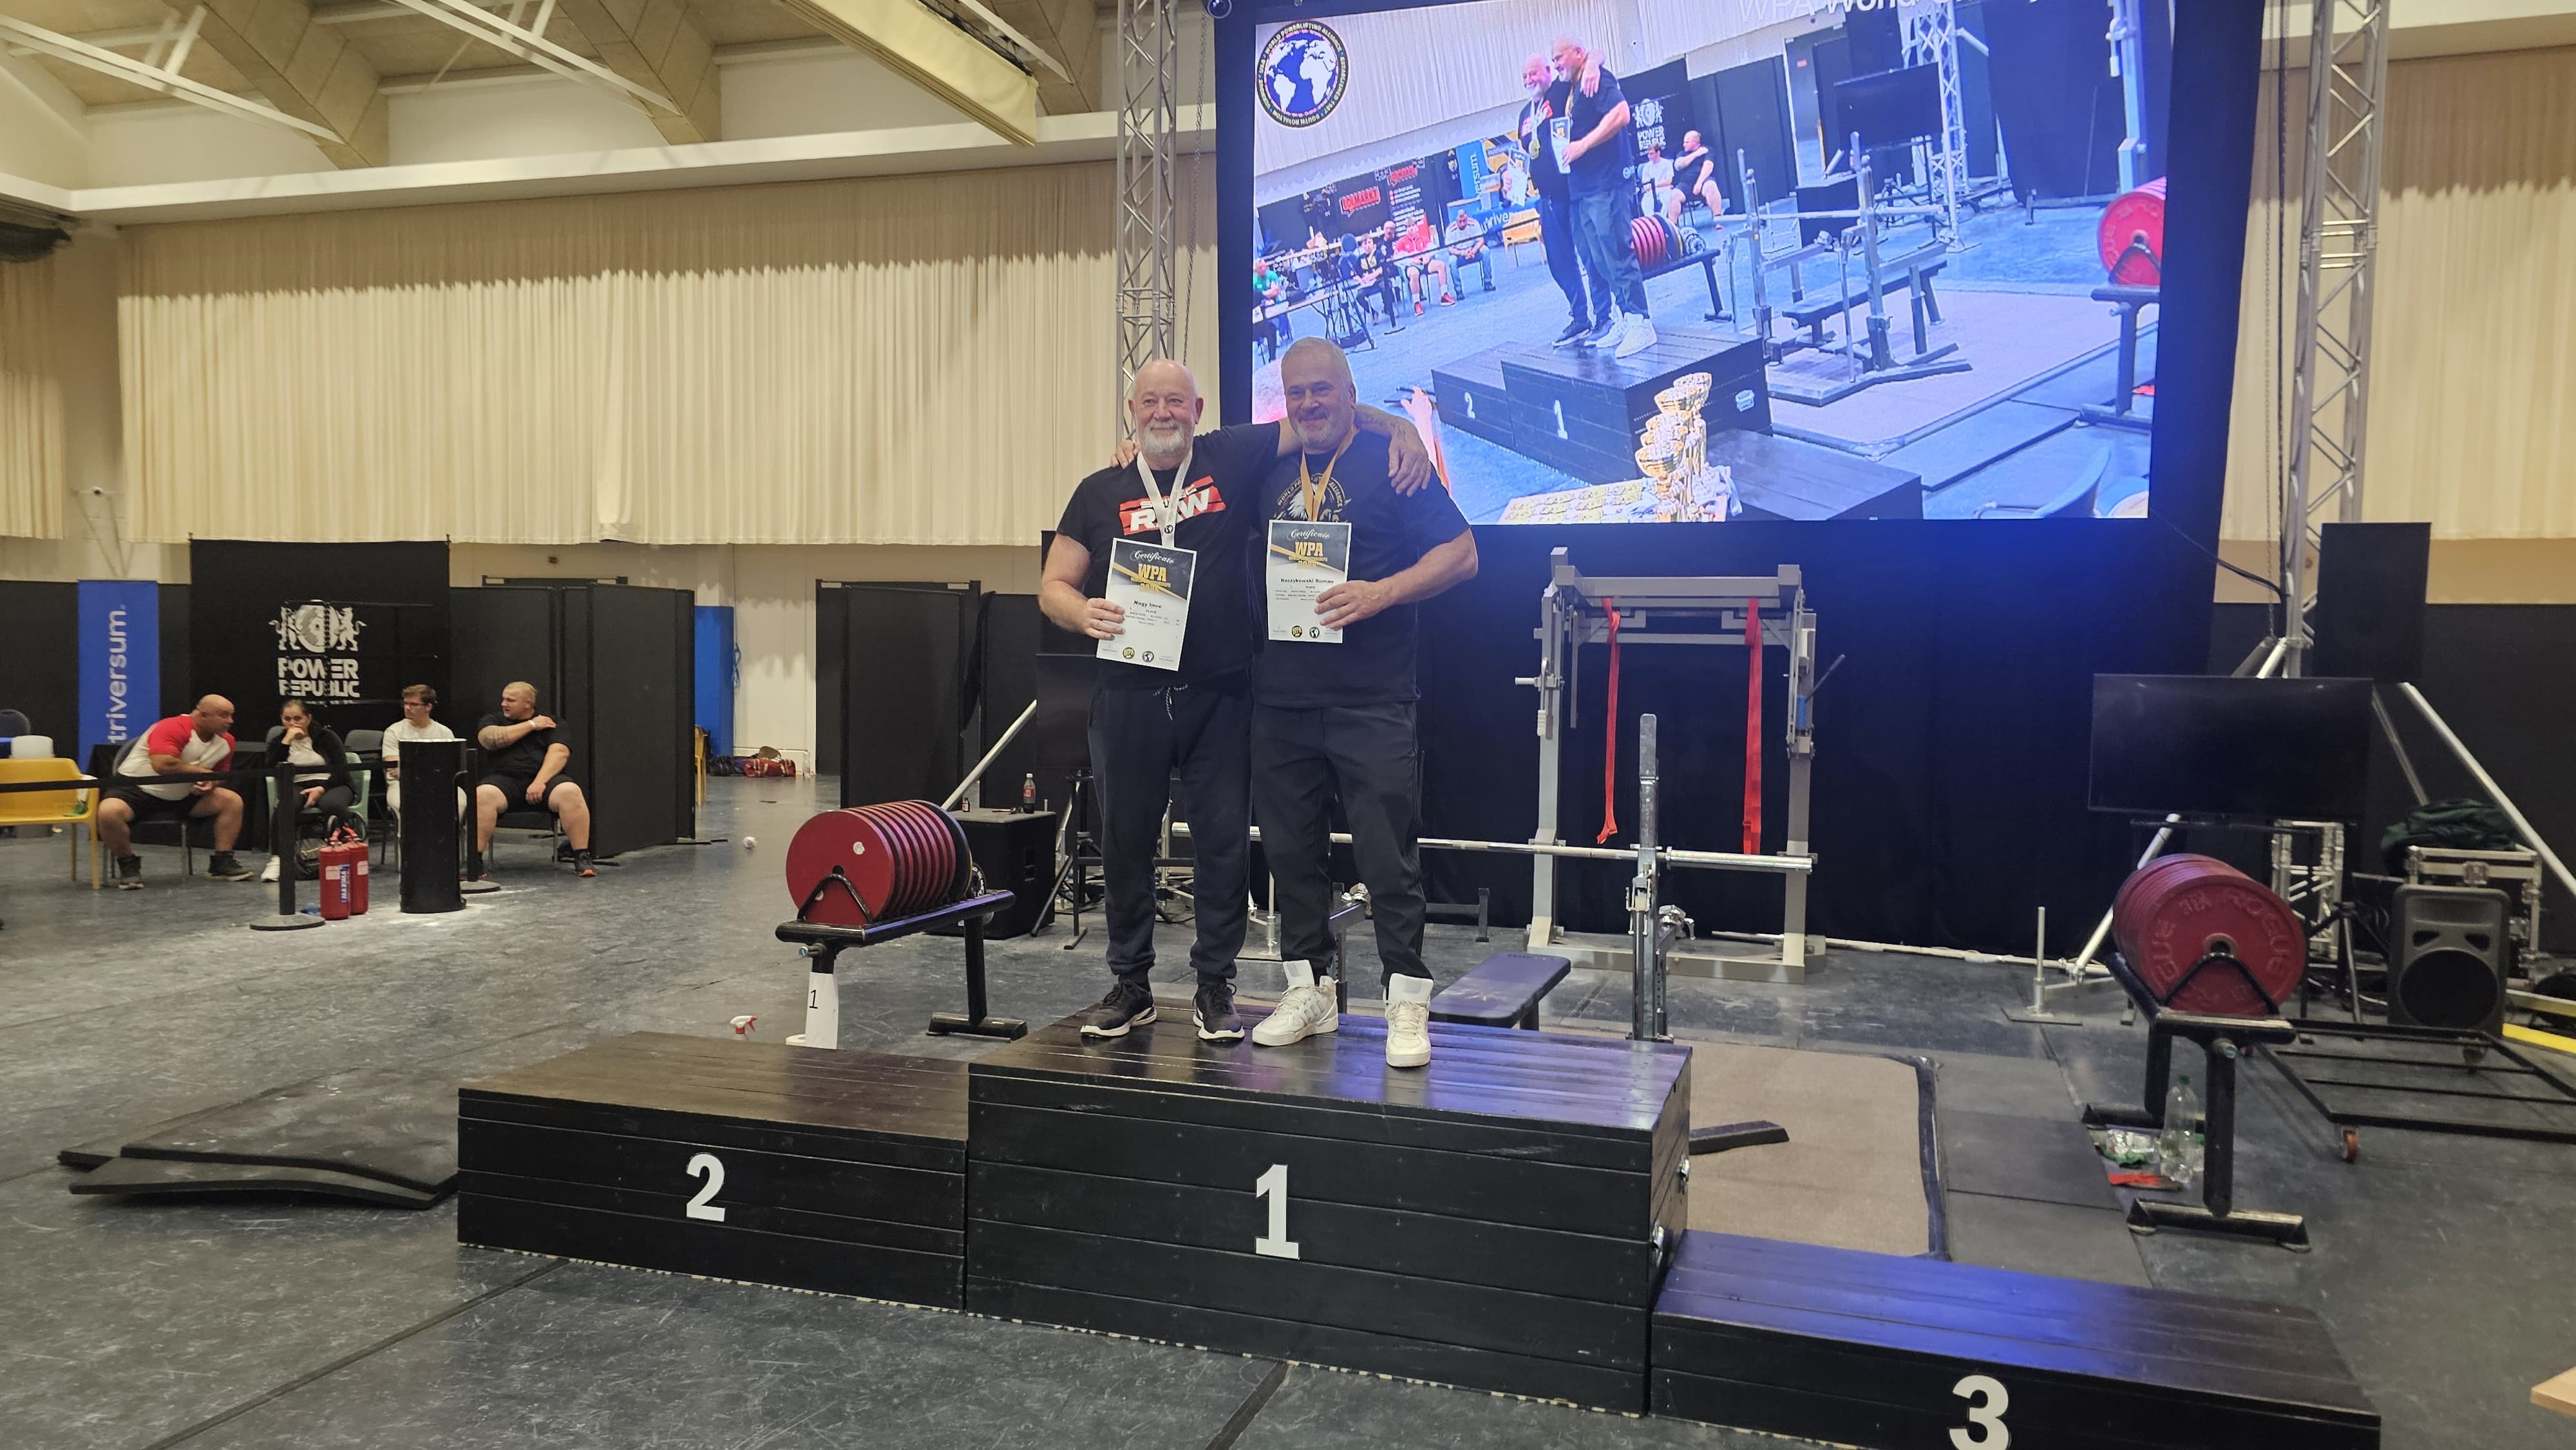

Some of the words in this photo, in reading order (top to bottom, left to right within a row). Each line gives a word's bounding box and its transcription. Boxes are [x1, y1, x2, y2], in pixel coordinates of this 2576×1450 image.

[1637, 126, 1665, 142] POWER
[1470, 153, 1481, 194] ersum
[1464, 391, 1476, 419] 2
[1553, 399, 1568, 440] 1
[1277, 485, 1295, 506] WORLD
[1288, 529, 1330, 540] Certificate
[1130, 550, 1175, 564] Certificate
[1294, 541, 1323, 557] WPA
[1138, 563, 1167, 582] WPA
[278, 657, 359, 679] POWER
[809, 990, 819, 1009] 1
[687, 1153, 726, 1222] 2
[1255, 1164, 1300, 1261] 1
[1949, 1375, 2009, 1450] 3
